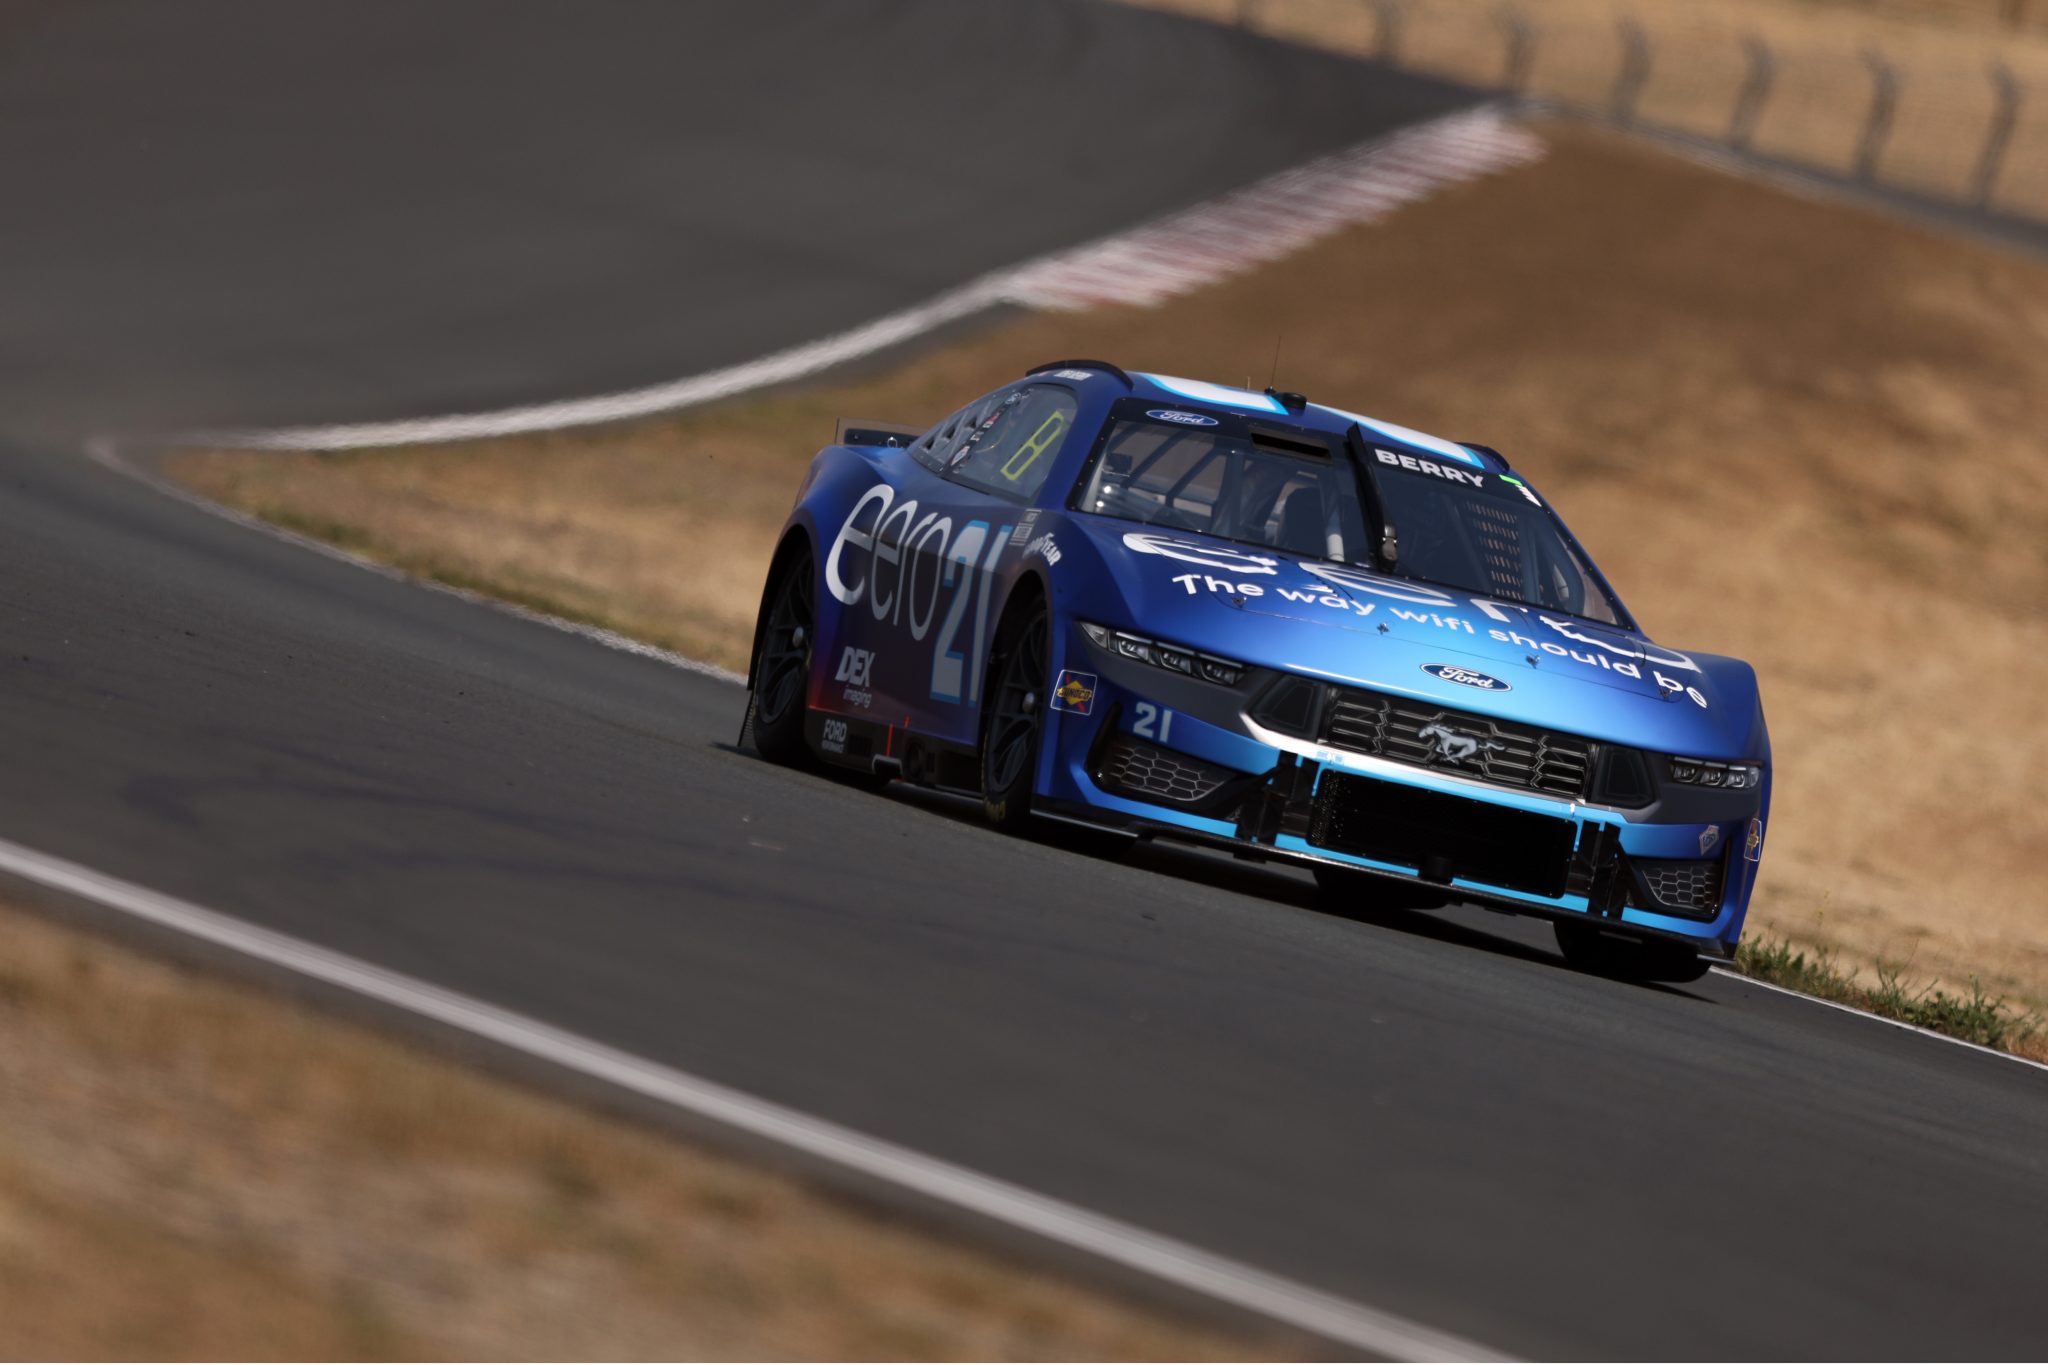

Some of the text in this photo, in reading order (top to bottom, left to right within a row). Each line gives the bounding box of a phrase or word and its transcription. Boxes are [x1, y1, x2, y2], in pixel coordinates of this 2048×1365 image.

[1375, 448, 1484, 488] BERRY
[825, 484, 952, 641] eero
[929, 519, 1013, 708] 21
[1172, 574, 1708, 709] The way wifi should be
[835, 646, 875, 688] DEX
[843, 686, 872, 709] imaging
[823, 718, 848, 743] FORD
[1132, 701, 1172, 743] 21
